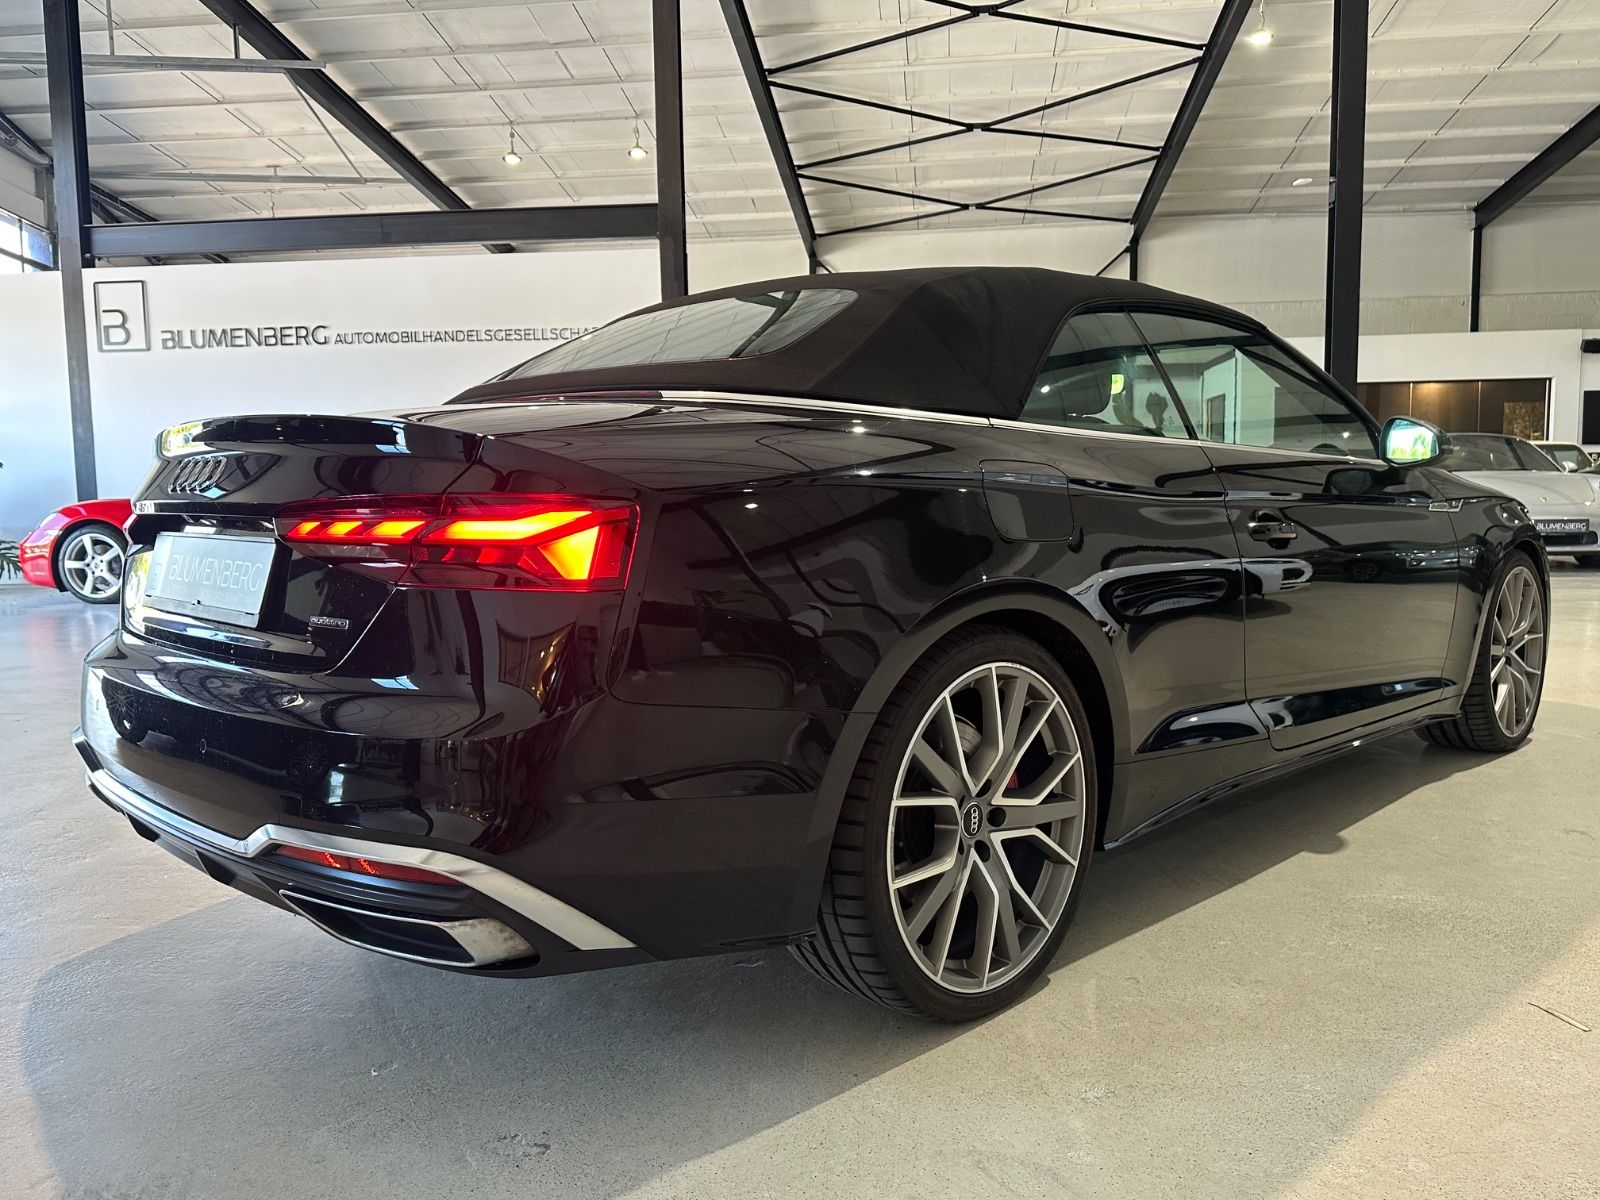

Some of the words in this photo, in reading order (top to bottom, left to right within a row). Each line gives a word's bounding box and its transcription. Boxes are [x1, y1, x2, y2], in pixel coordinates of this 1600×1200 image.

[161, 325, 329, 350] BLUMENBERG
[333, 326, 600, 345] AUTOMOBILHANDELSGESELLSCH
[1536, 522, 1587, 530] BLUMENBERG
[168, 554, 264, 592] BLUMENBERG
